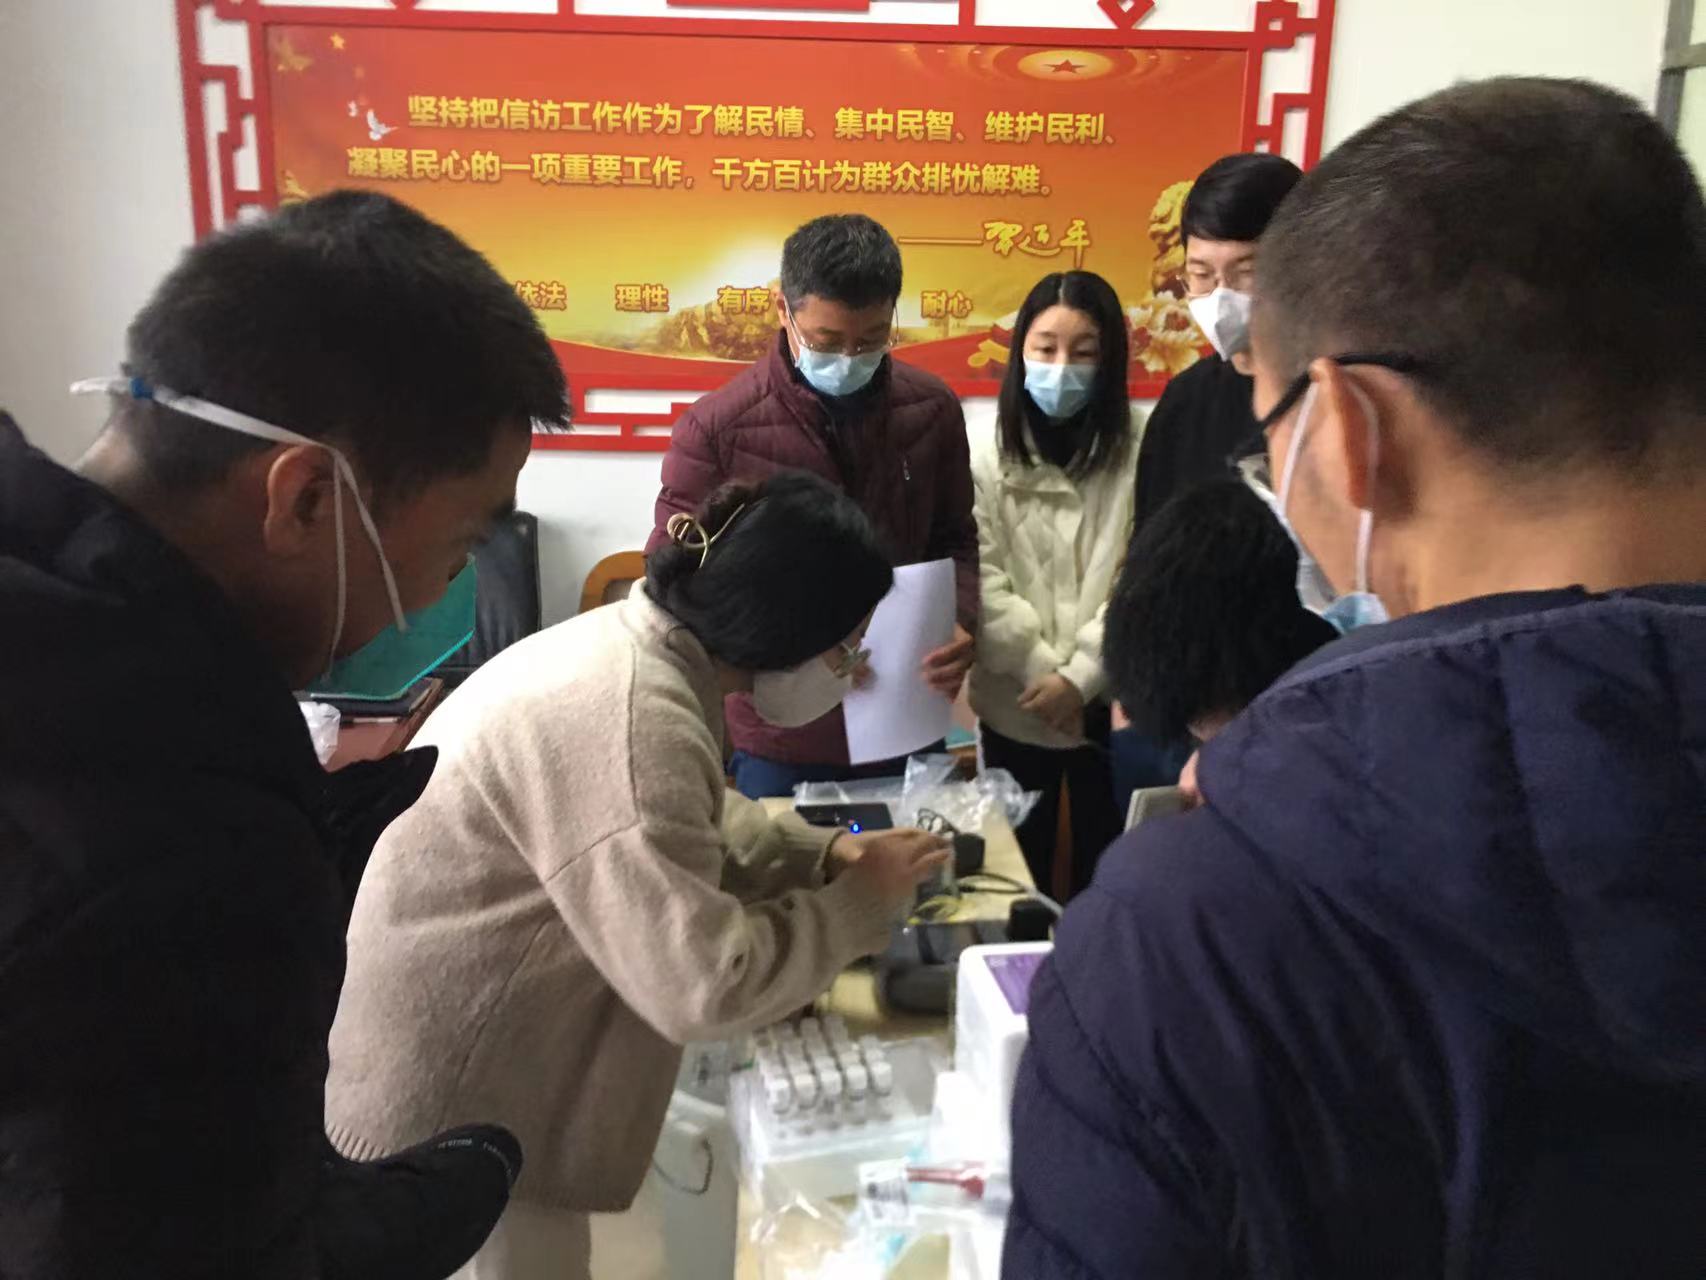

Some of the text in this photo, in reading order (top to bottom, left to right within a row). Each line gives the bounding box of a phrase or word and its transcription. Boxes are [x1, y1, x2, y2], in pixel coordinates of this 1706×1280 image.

[408, 95, 1115, 146] 坚持把信访工作作为了解民情、集中民智、维护民利、
[615, 283, 669, 312] 理性
[717, 285, 772, 315] 有序
[921, 289, 973, 319] 耐心
